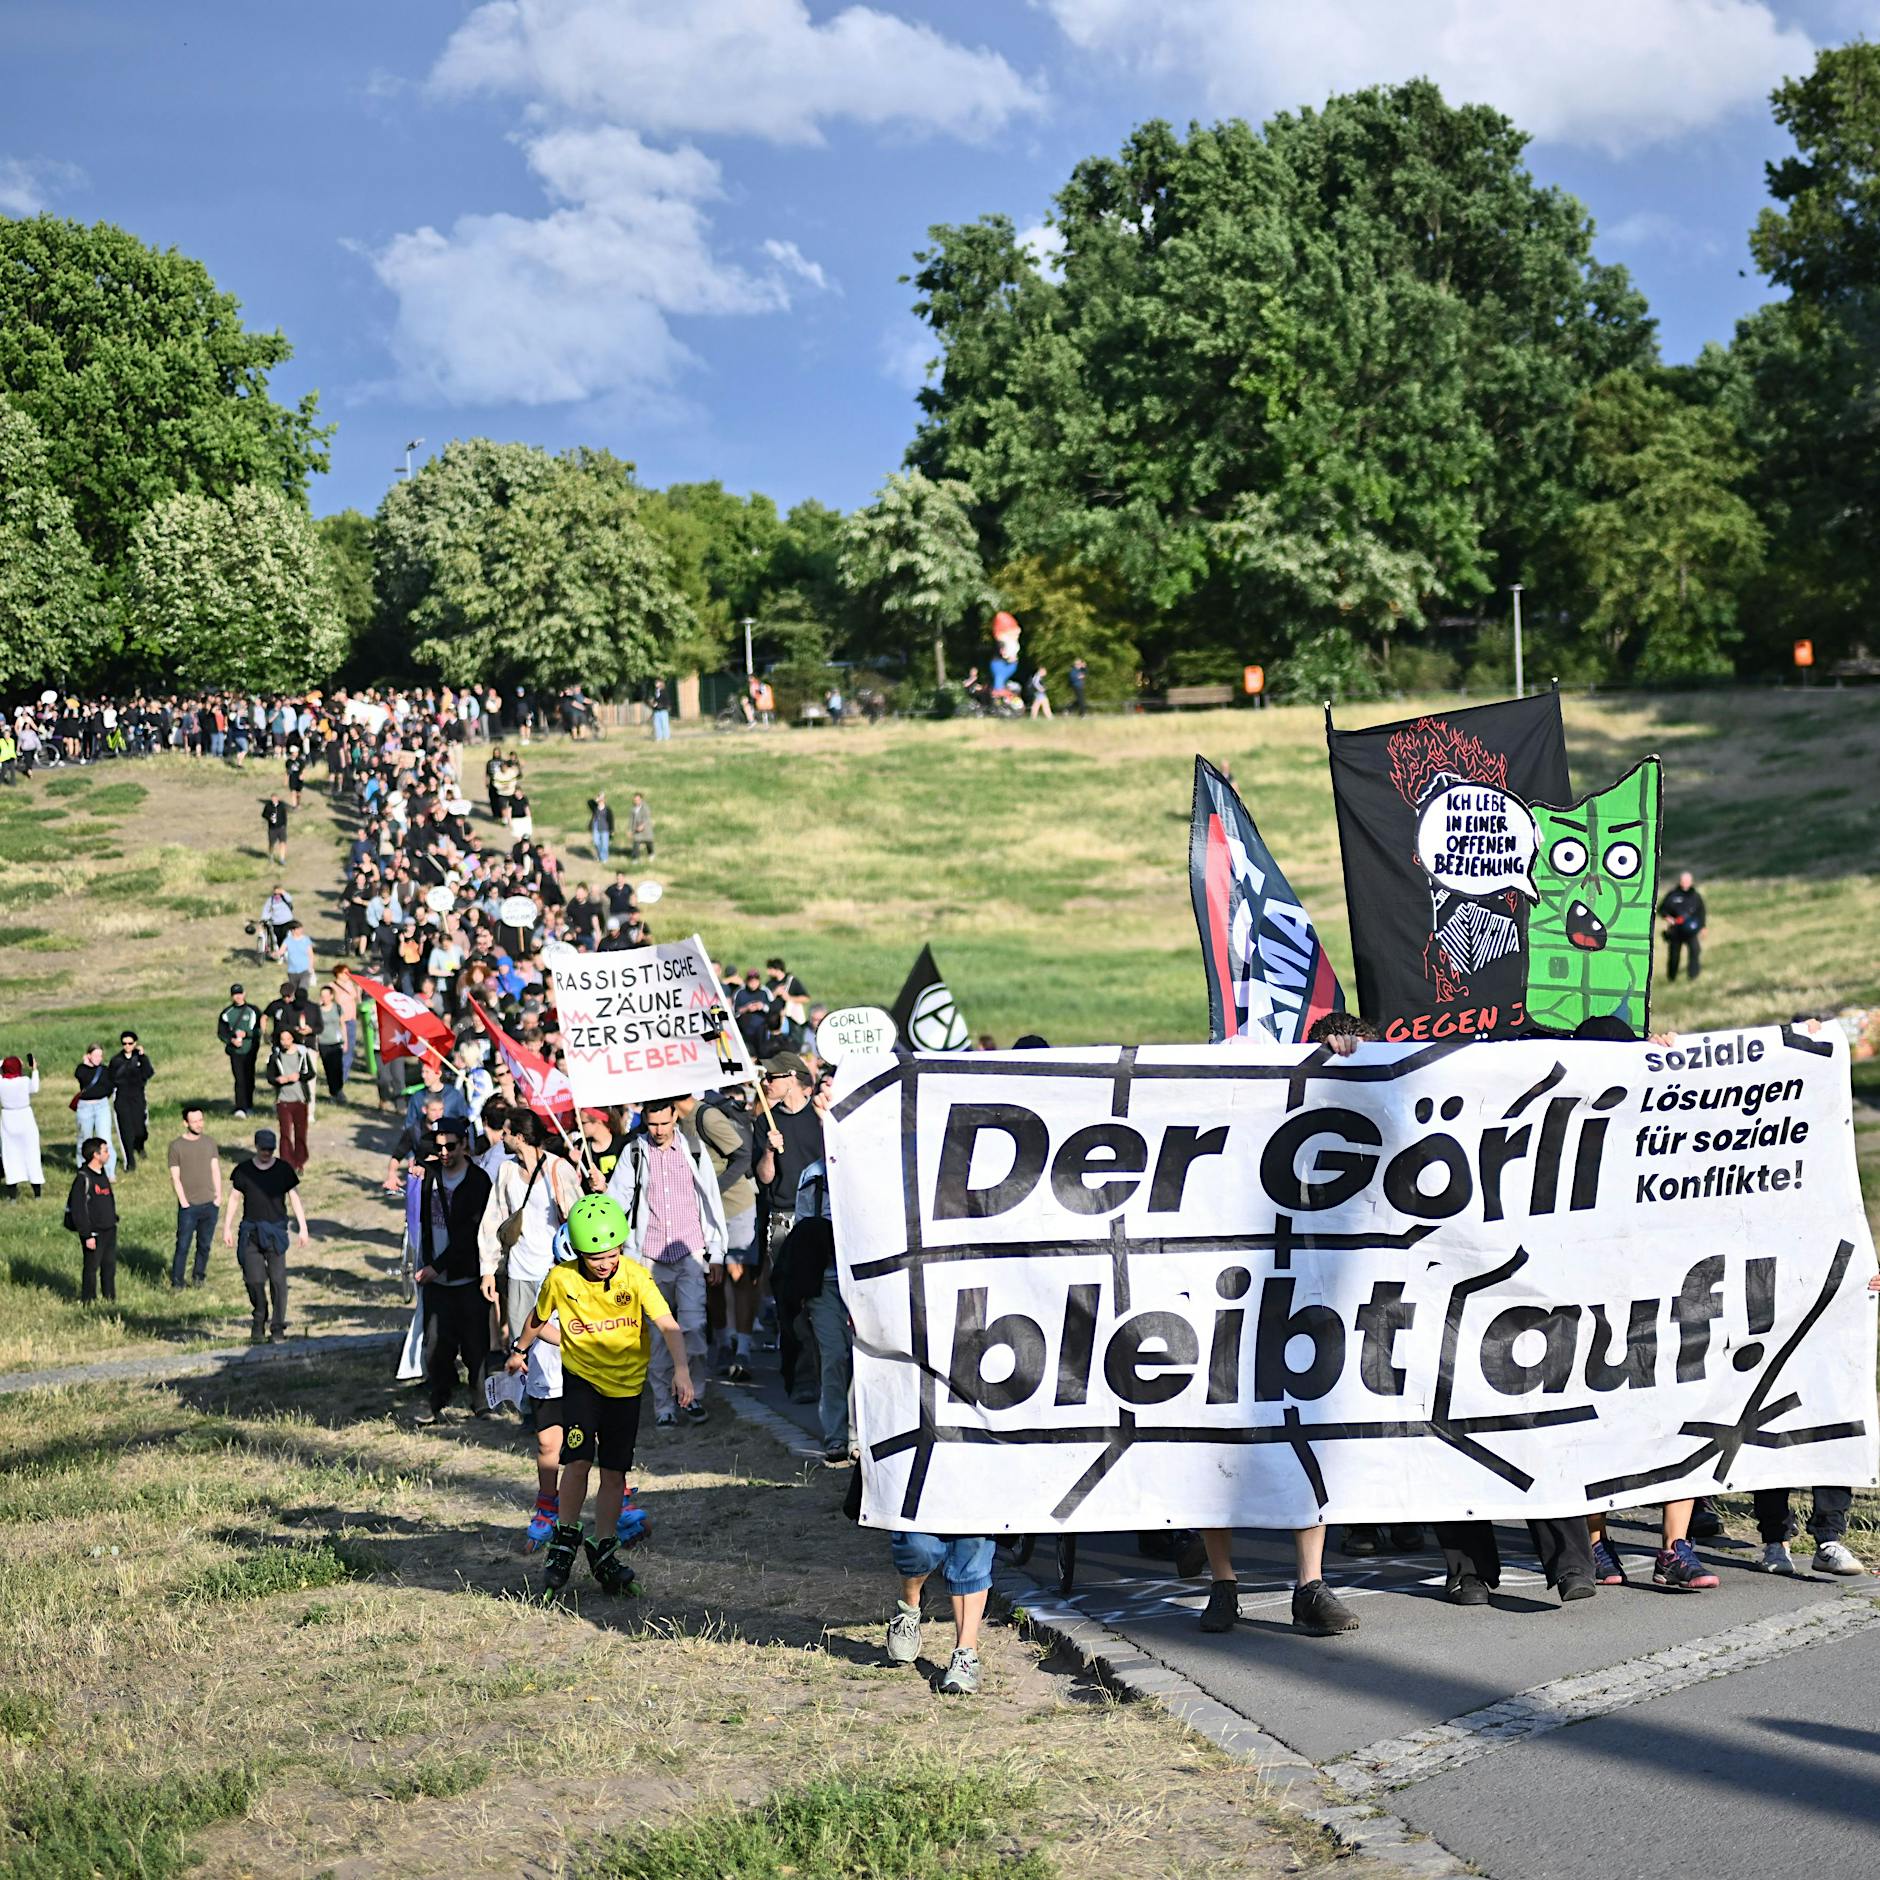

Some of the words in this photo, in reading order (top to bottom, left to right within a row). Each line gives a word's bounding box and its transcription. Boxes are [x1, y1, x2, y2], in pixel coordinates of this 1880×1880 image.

[1447, 793, 1471, 811] ICH
[1476, 794, 1506, 813] LEBE
[1446, 815, 1462, 832] IN
[1465, 815, 1508, 834] EINER
[1446, 835, 1516, 854] OFFENEN
[1434, 853, 1524, 877] BEZIEHUNG
[556, 956, 698, 991] RASSISTISCHE
[596, 988, 683, 1018] ZÄUNE
[571, 1010, 718, 1047] ZERSTÖREN
[839, 1028, 884, 1045] BLEIBT
[1385, 1006, 1498, 1042] GEGEN
[606, 1041, 699, 1075] LEBEN
[1645, 1034, 1765, 1072] soziale
[1640, 1078, 1804, 1116] Lösungen
[1635, 1125, 1688, 1157] für
[1692, 1116, 1809, 1152] soziale
[932, 1103, 1231, 1221] Der
[1260, 1086, 1628, 1223] Görli
[1635, 1160, 1804, 1204] Konflikte!
[616, 1291, 631, 1303] BVB
[947, 1265, 1418, 1411] bleibt
[1479, 1254, 1778, 1396] auf!
